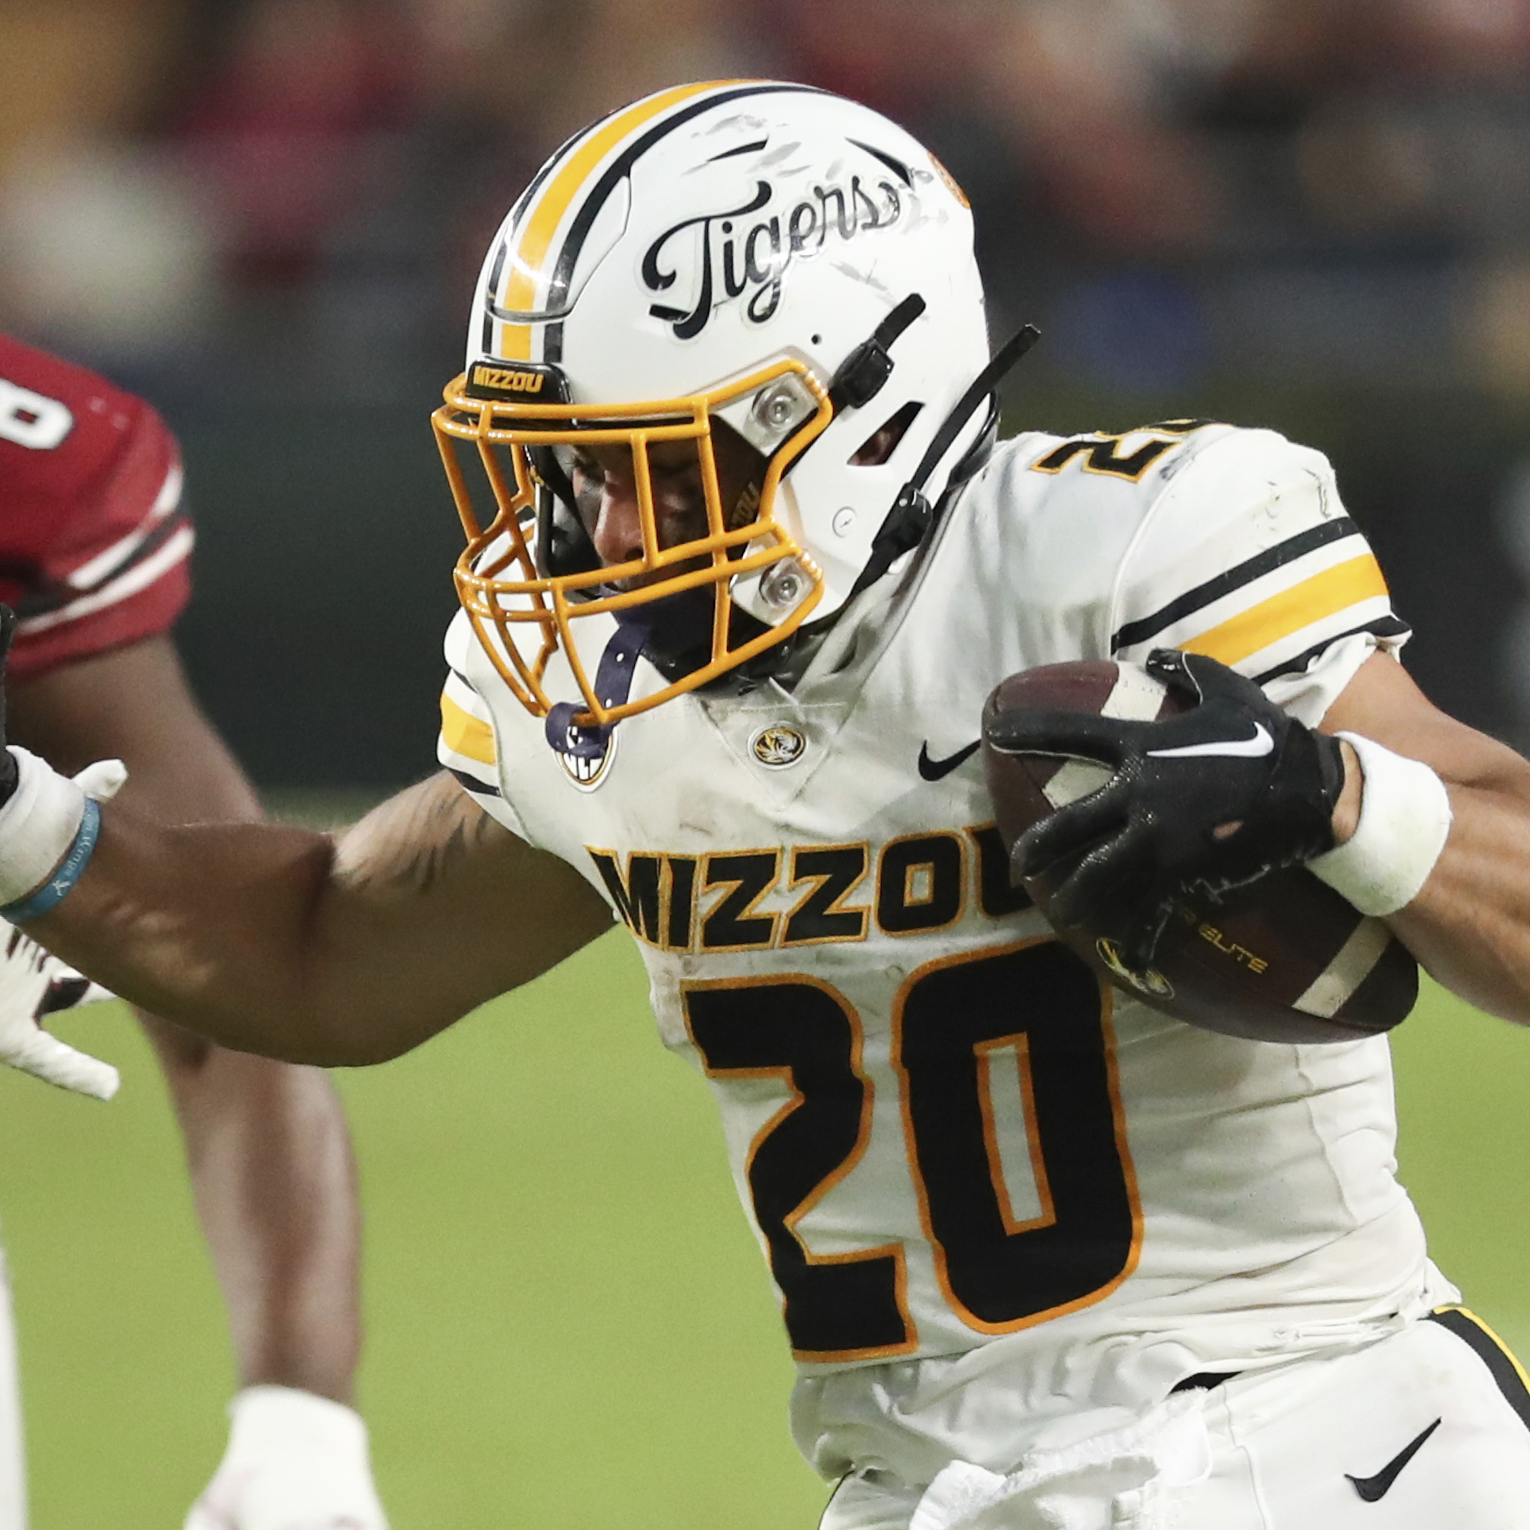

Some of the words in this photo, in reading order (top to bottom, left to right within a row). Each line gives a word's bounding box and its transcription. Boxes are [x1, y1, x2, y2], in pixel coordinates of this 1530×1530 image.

[642, 174, 902, 340] Tigers
[473, 365, 545, 393] MIZZOU
[679, 936, 1144, 1363] 20
